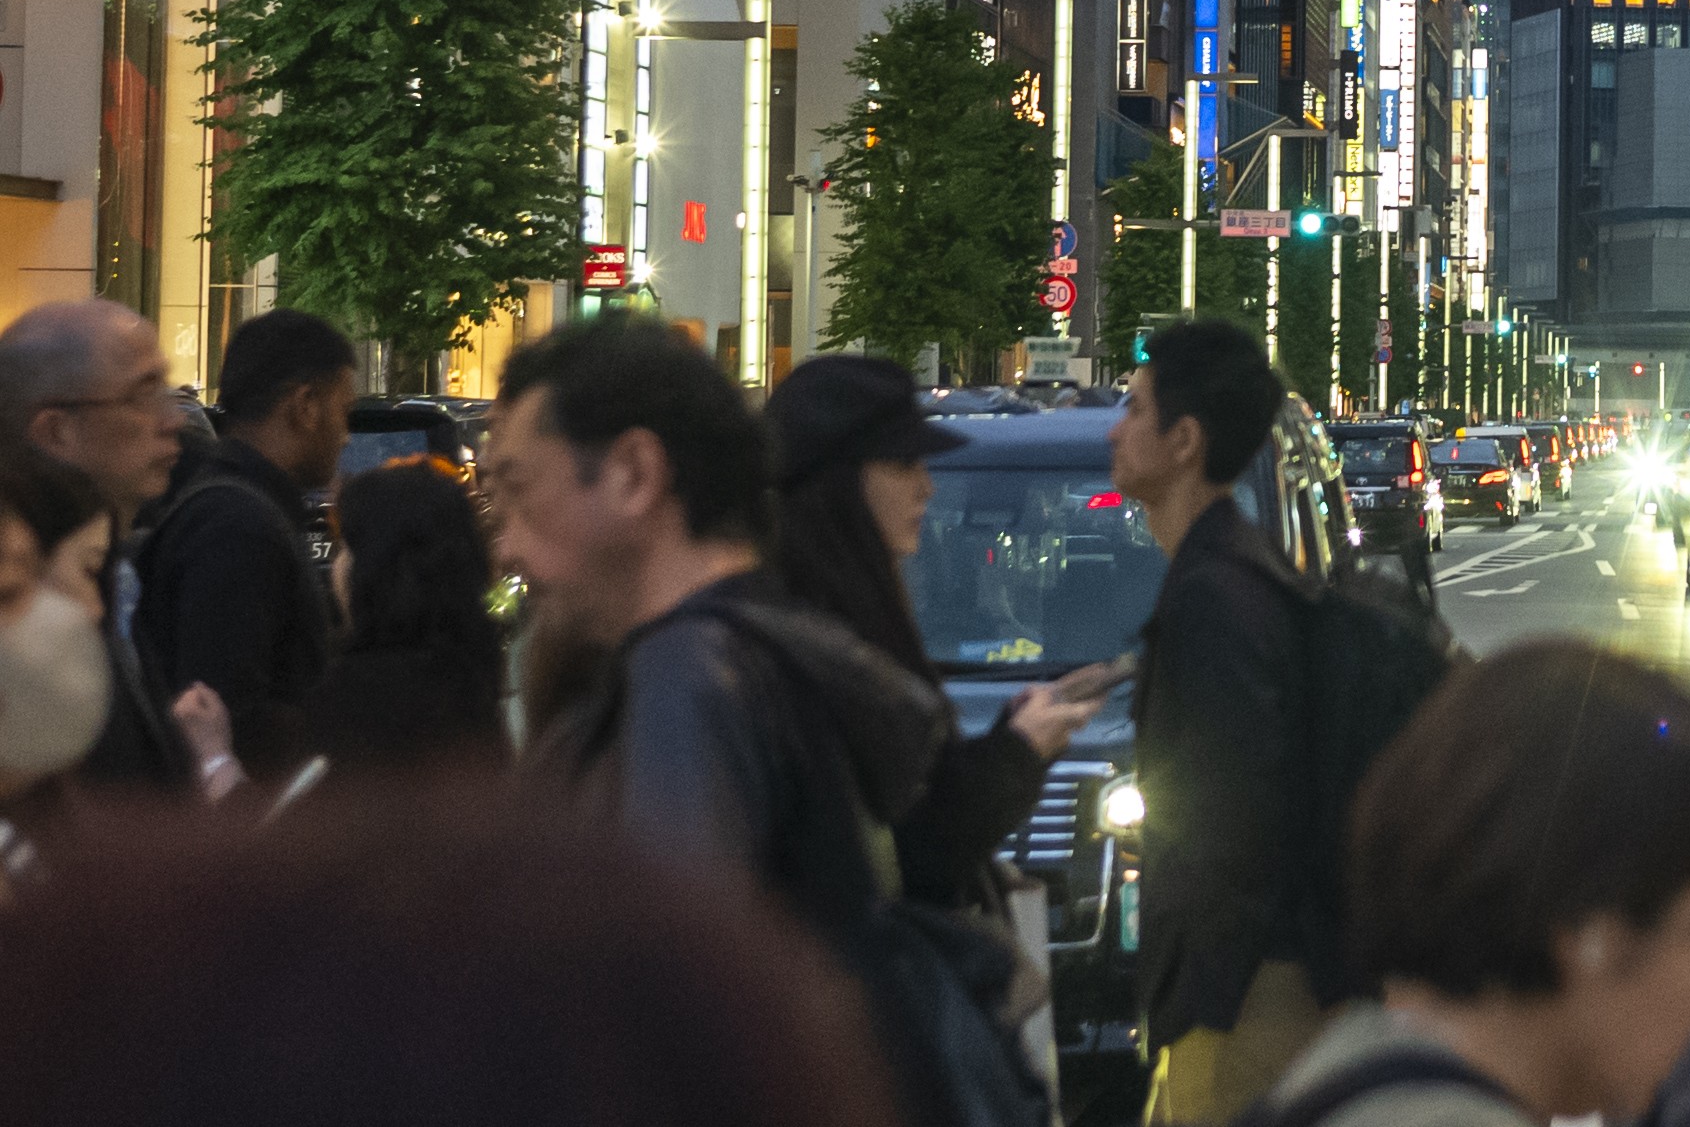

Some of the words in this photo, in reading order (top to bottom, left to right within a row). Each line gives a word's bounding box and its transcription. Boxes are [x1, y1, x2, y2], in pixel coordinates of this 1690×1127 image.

[1202, 37, 1211, 88] CHAUMT
[1345, 72, 1354, 120] I-PRIMO
[1226, 216, 1286, 229] 銀座三丁目
[585, 252, 625, 264] OKS
[1048, 285, 1068, 303] 50
